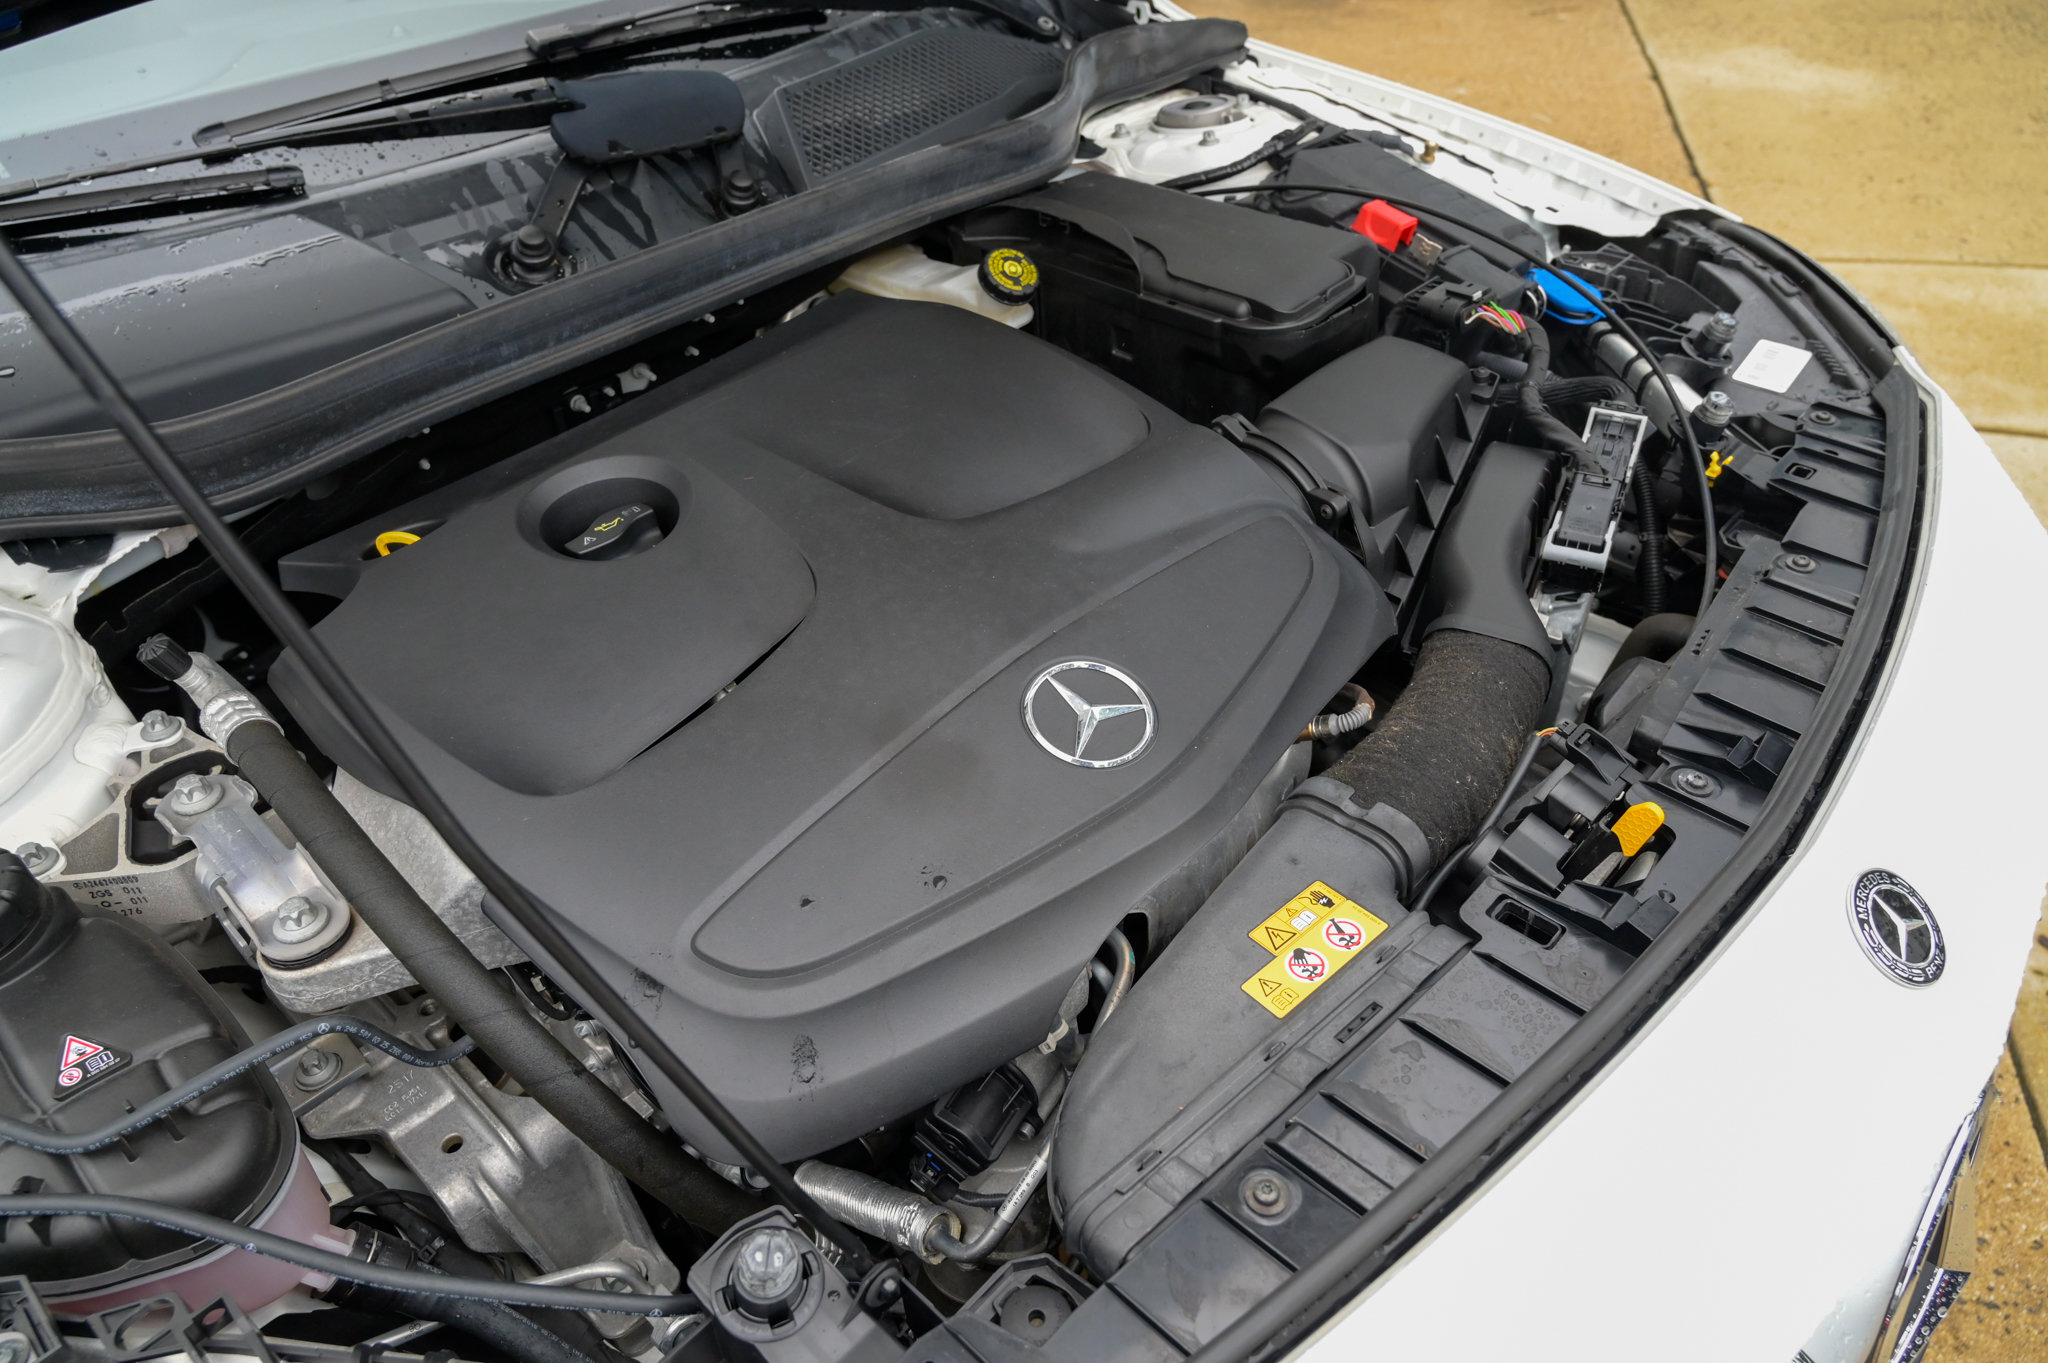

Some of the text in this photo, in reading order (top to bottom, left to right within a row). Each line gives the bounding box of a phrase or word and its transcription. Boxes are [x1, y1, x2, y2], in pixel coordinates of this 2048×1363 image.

[1856, 872, 1944, 979] MERCEDES BENZ
[344, 1025, 358, 1034] 246
